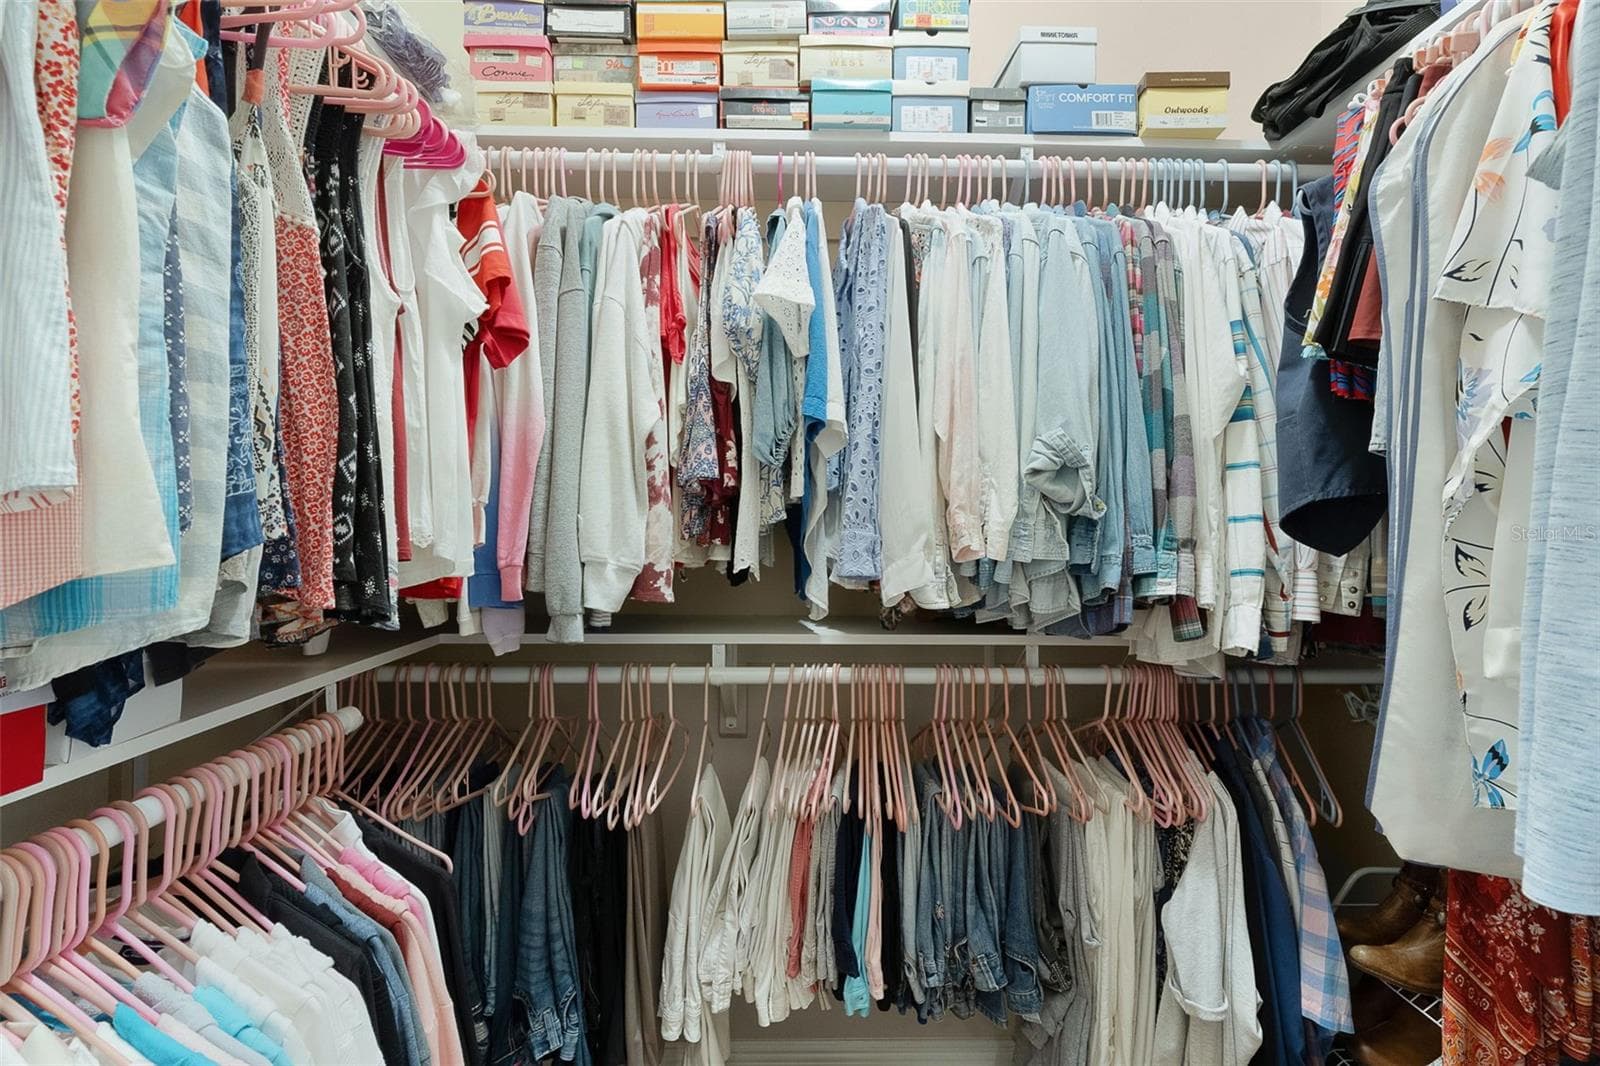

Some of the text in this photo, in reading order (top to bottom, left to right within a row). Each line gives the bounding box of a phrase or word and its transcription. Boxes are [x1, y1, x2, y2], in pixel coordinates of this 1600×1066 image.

[481, 66, 534, 78] Connie
[1058, 93, 1114, 103] COMFORT
[1118, 94, 1135, 104] FIT
